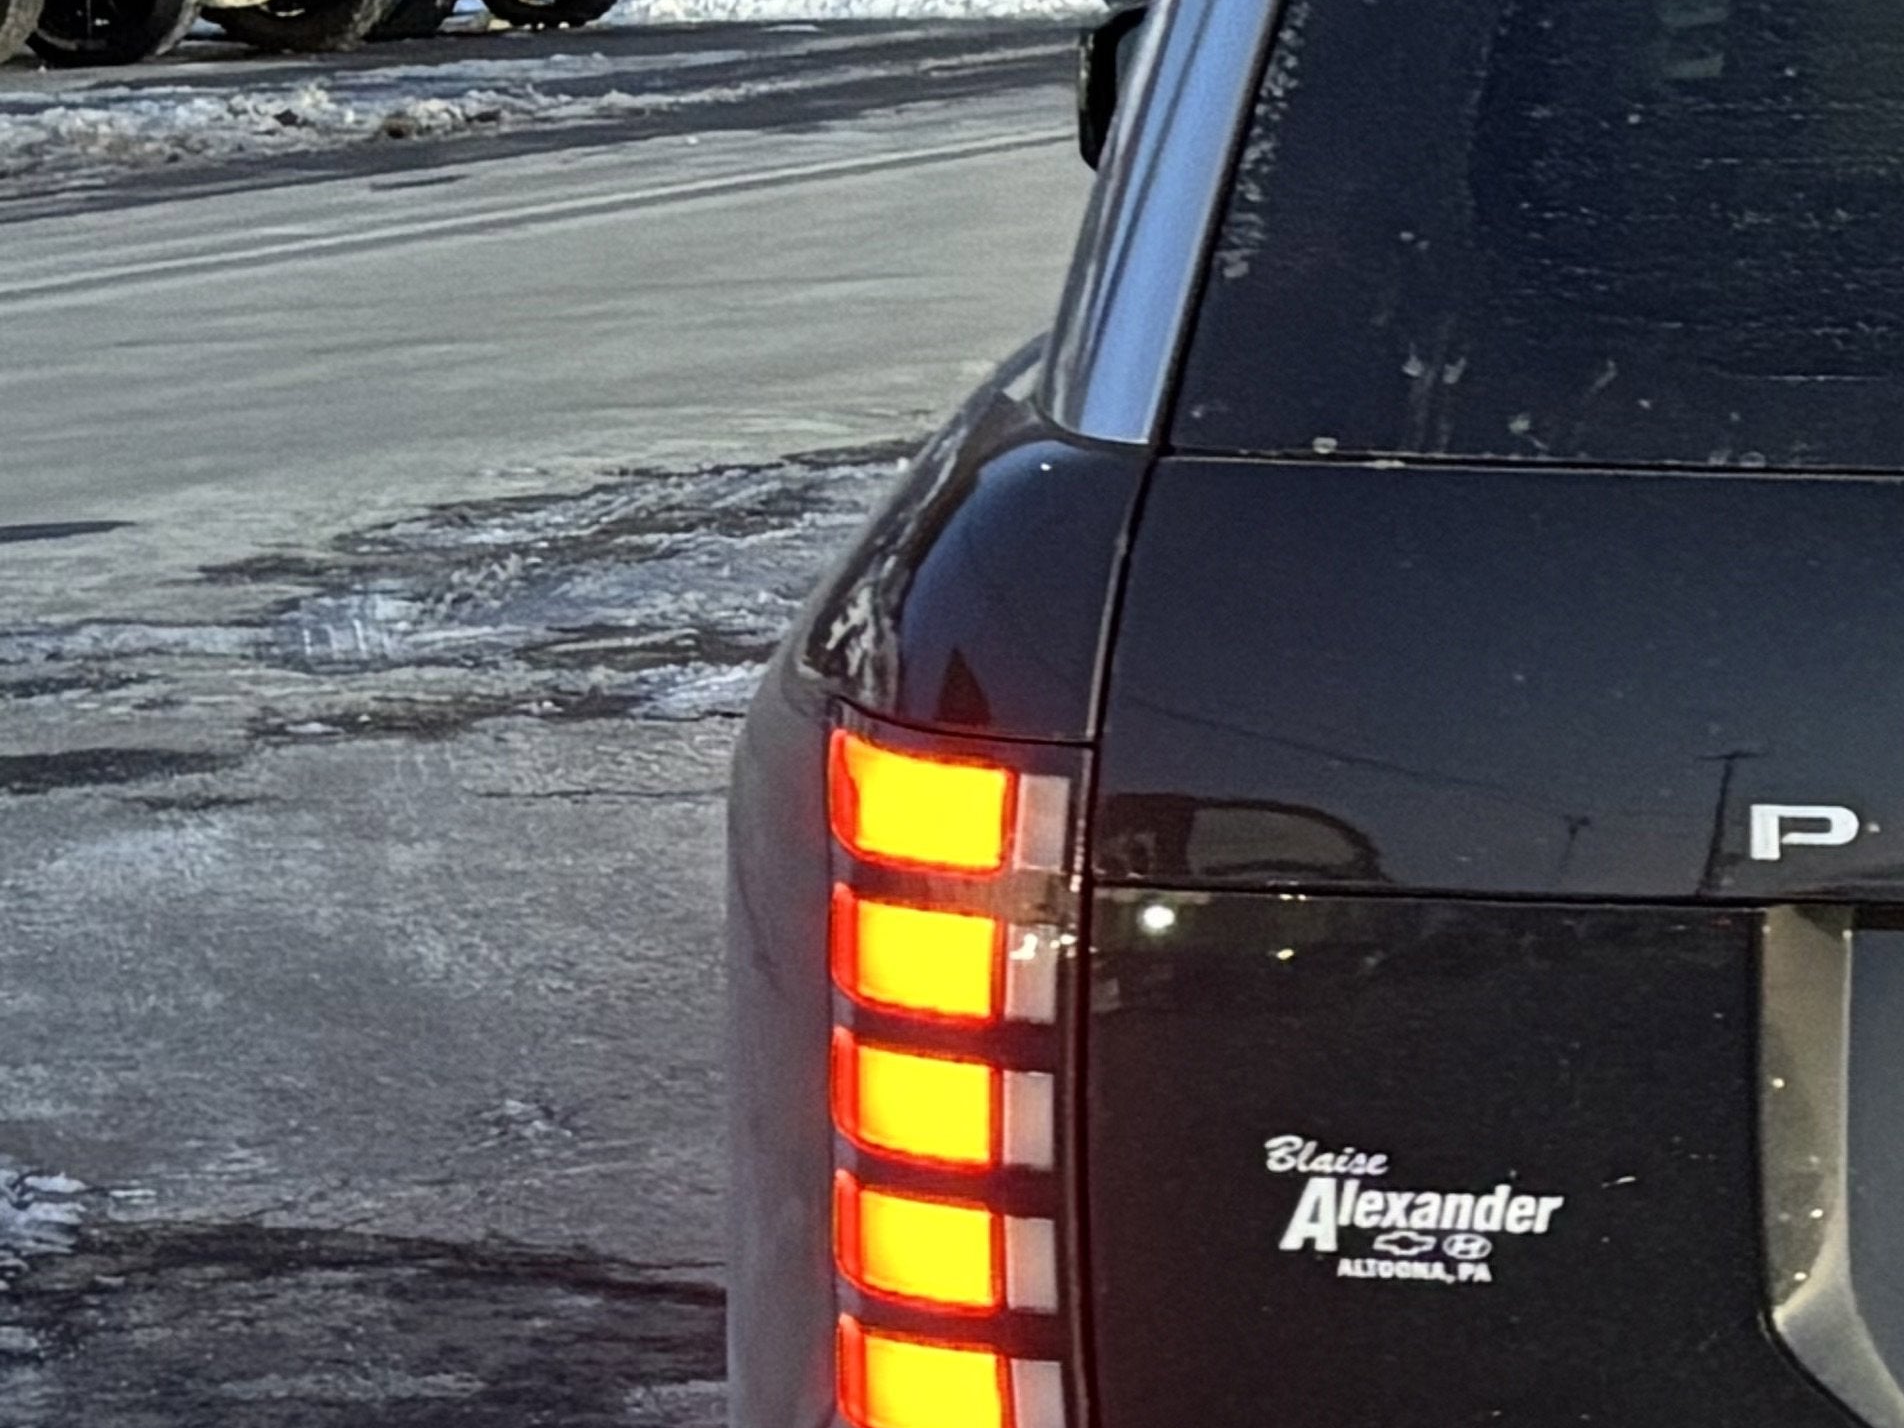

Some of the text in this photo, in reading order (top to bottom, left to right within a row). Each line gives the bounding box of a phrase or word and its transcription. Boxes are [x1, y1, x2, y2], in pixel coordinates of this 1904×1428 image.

[1264, 1134, 1390, 1175] Blaise
[1278, 1176, 1565, 1252] Alexander
[1456, 1261, 1493, 1282] PA
